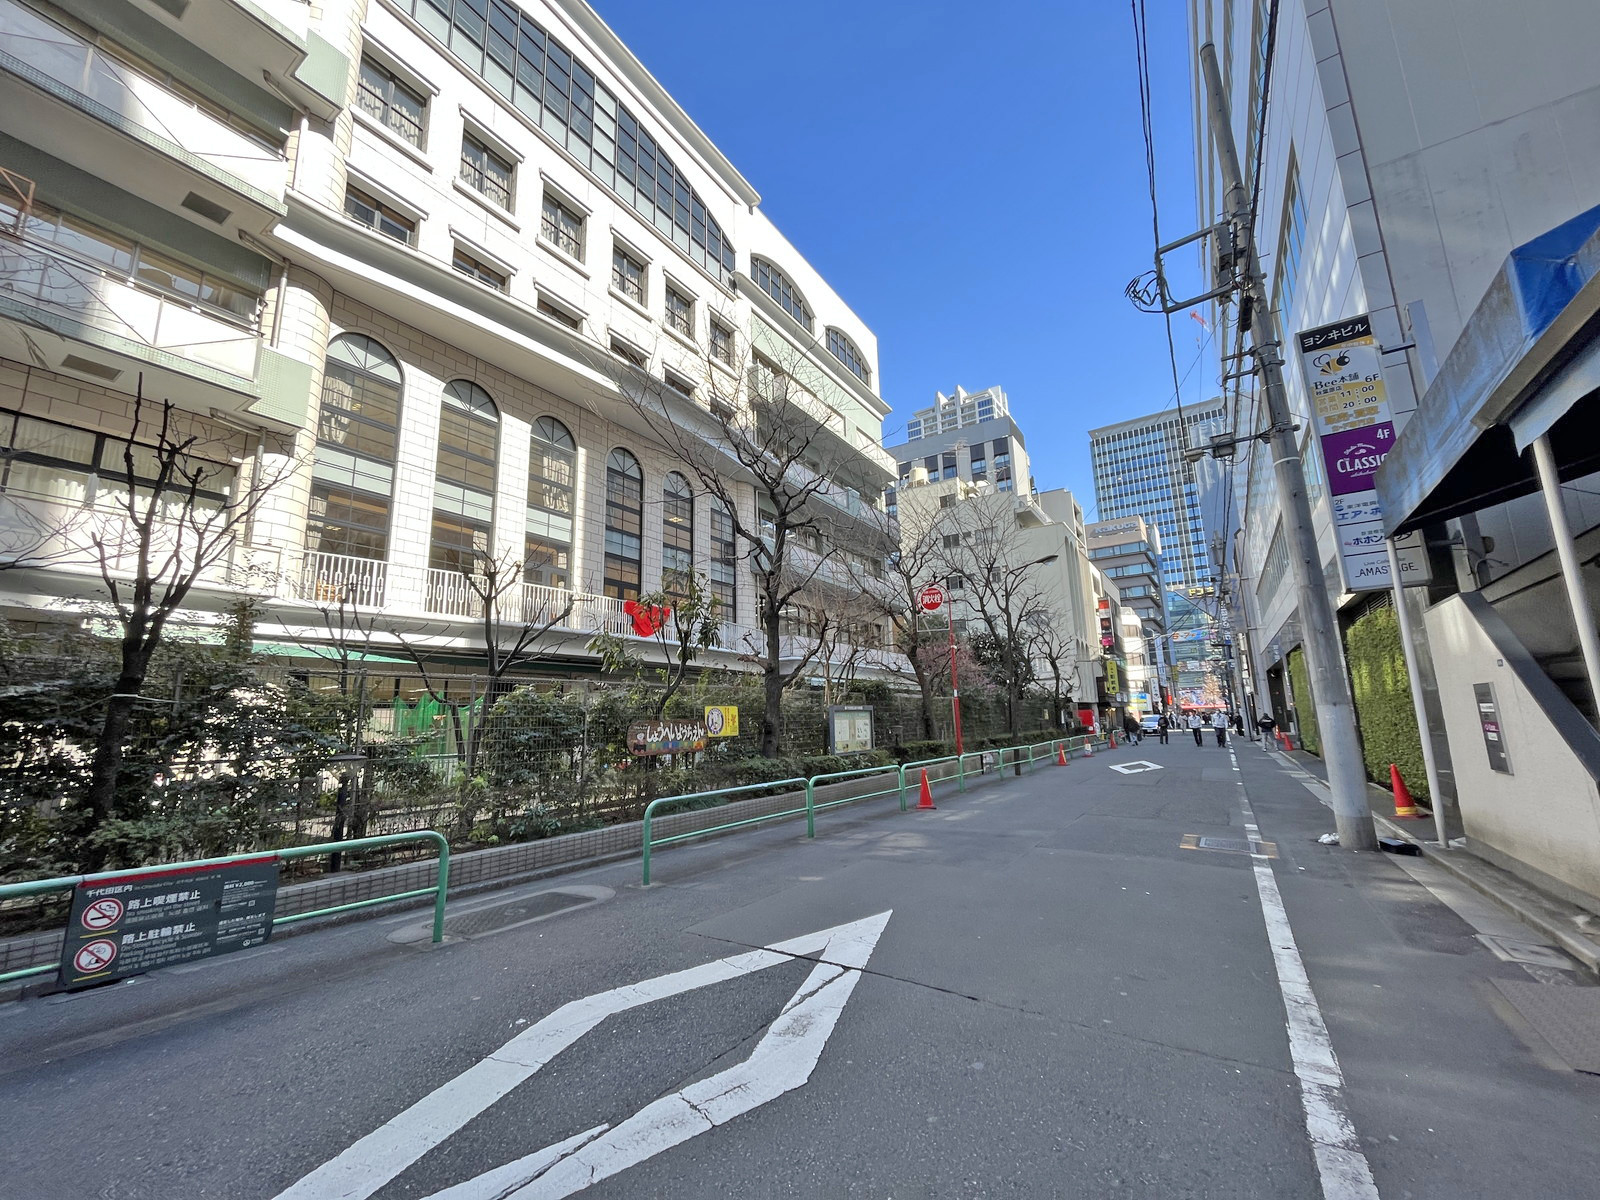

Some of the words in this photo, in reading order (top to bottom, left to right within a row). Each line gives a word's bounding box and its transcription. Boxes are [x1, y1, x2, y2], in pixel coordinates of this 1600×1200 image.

[1365, 373, 1379, 383] 6F
[1376, 428, 1390, 440] 4F
[922, 593, 942, 604] 消火栓
[87, 885, 133, 898] 千代田区内
[127, 890, 200, 910] 路上喫煙禁止
[122, 922, 196, 945] 路上駐輪禁止
